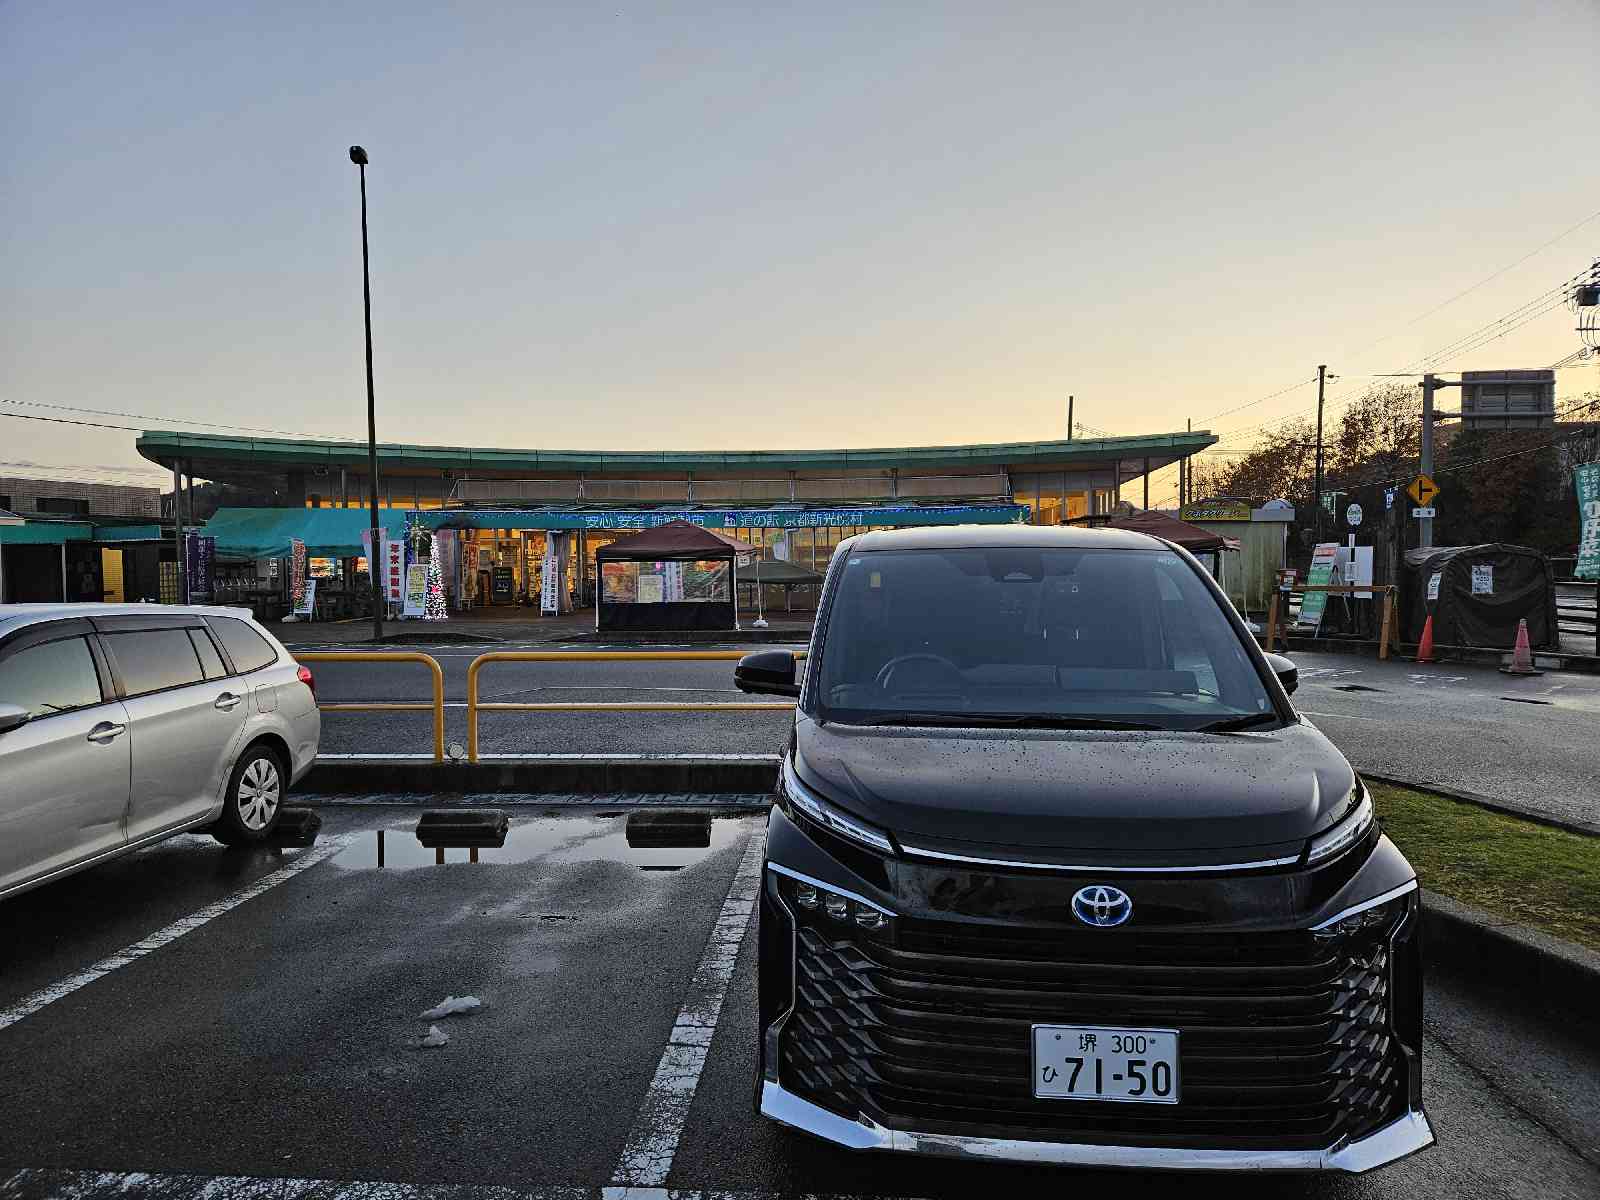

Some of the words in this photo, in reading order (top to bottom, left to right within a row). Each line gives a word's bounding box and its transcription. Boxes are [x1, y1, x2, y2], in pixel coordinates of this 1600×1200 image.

[585, 513, 613, 528] 安心
[1078, 1033, 1097, 1053] 堺
[1111, 1035, 1147, 1054] 300
[1042, 1065, 1059, 1083] ひ
[1064, 1057, 1171, 1097] 71-50
